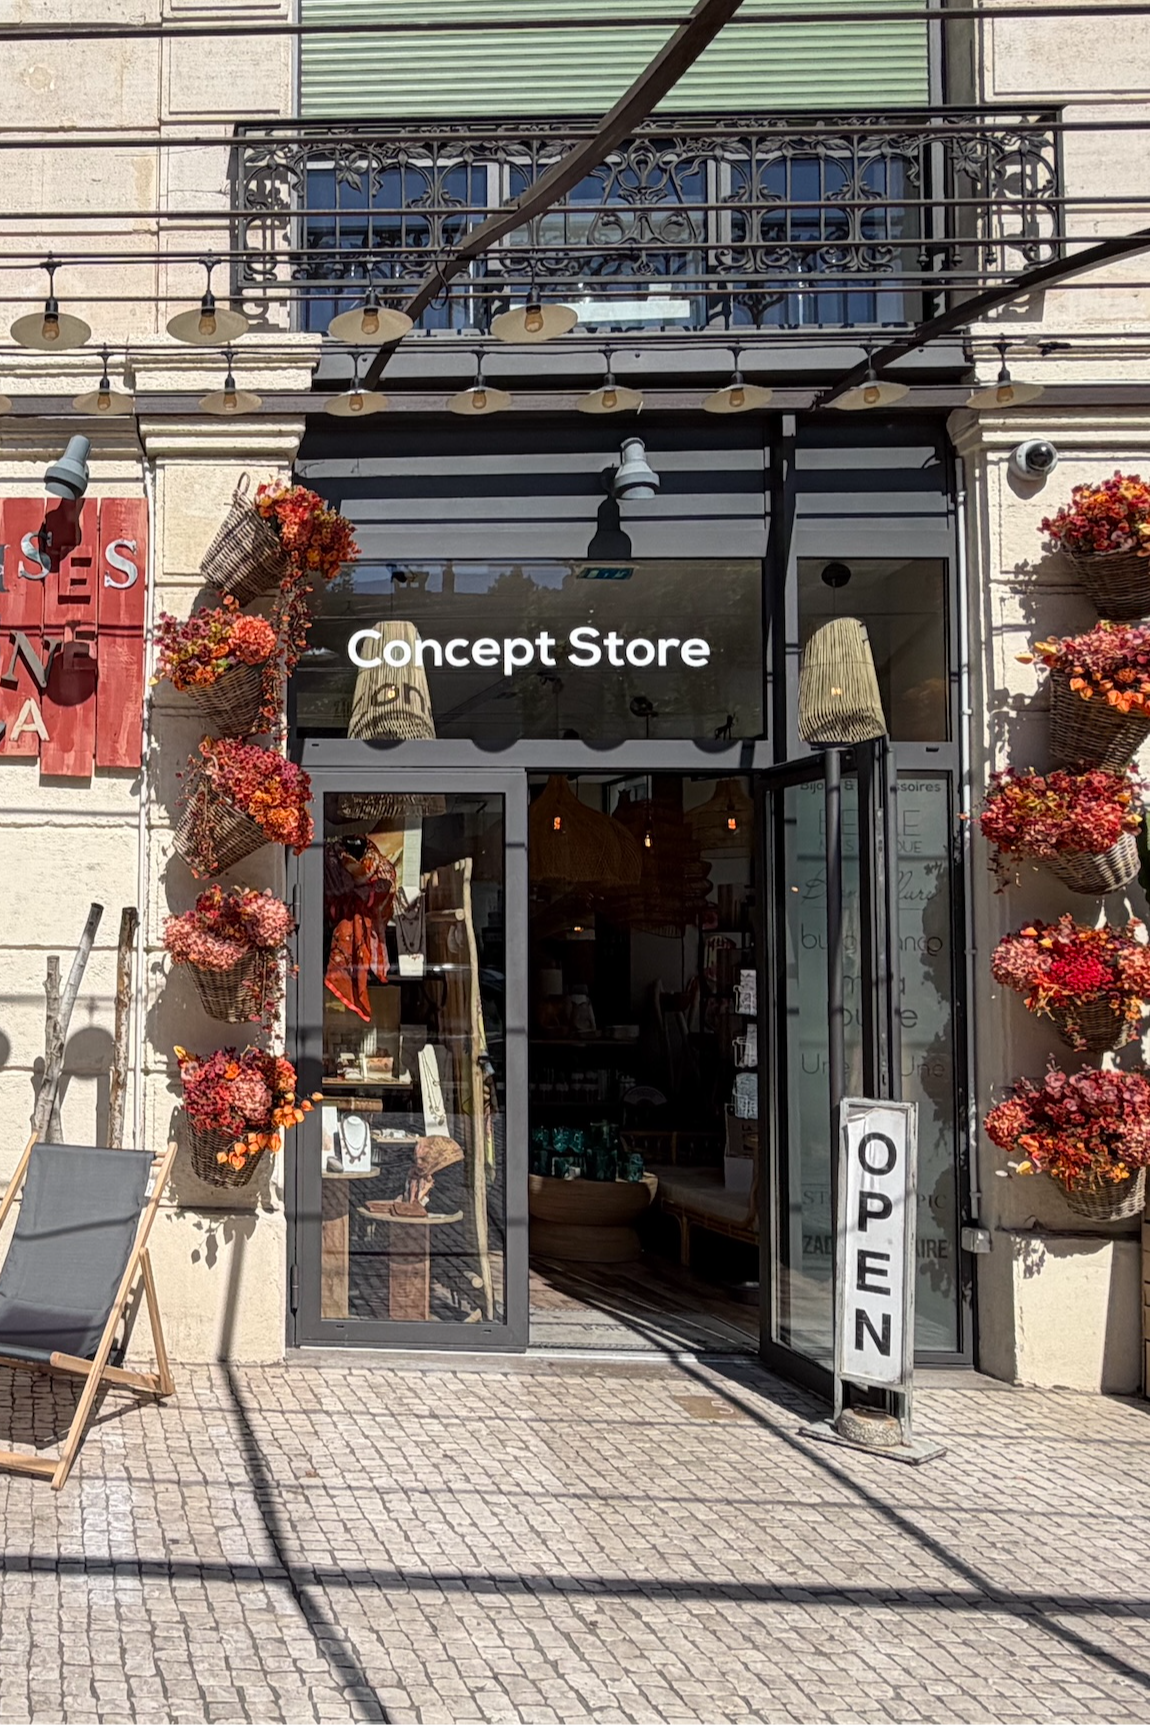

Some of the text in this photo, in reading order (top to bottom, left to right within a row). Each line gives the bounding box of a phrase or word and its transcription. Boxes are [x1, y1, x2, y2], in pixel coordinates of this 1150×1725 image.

[347, 626, 711, 676] Concept Store
[854, 1132, 897, 1356] OPEN
